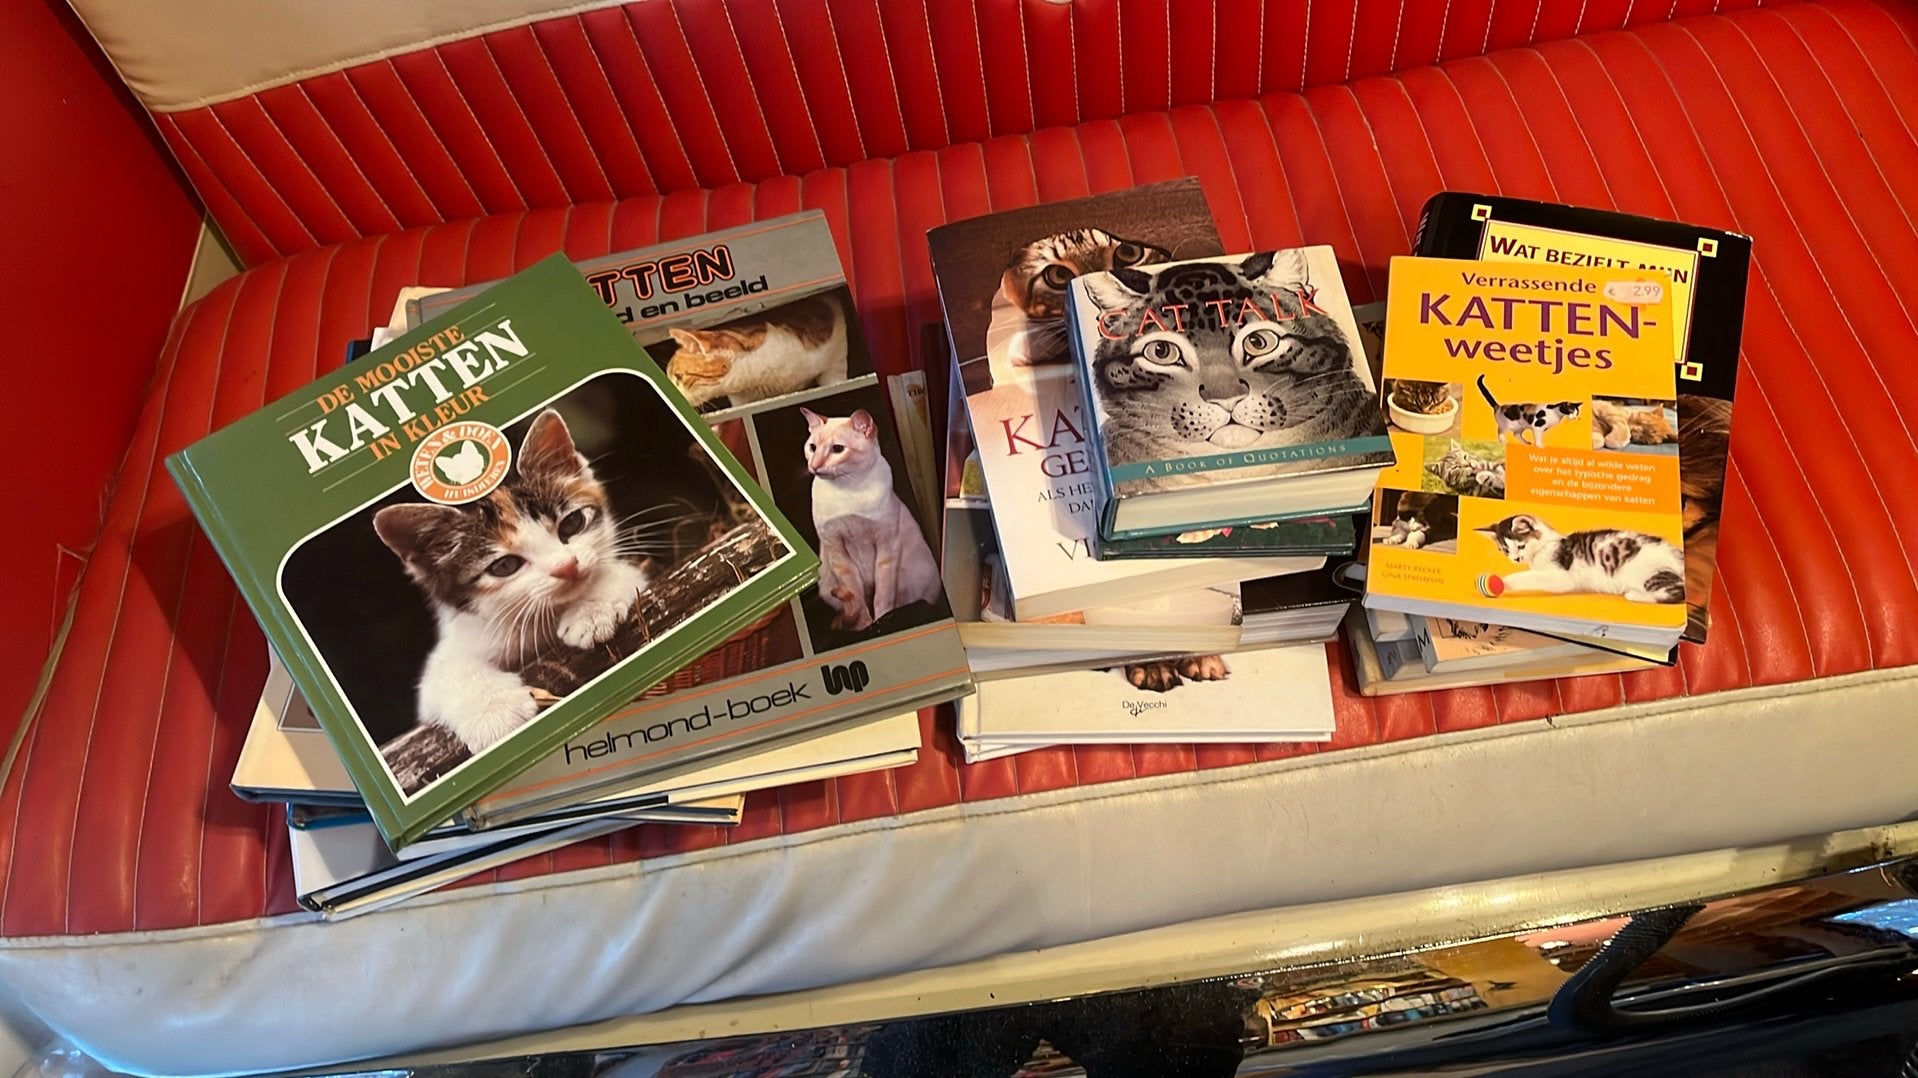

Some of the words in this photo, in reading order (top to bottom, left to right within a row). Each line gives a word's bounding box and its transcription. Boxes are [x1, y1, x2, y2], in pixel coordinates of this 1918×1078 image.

[1490, 236, 1541, 259] WAT
[587, 244, 735, 307] TTEN
[1462, 272, 1597, 293] Verrassende
[641, 300, 680, 318] en
[684, 275, 769, 308] beeld
[1633, 284, 1661, 297] 2.99
[1098, 303, 1189, 340] CAT
[1205, 288, 1328, 328] TALK
[1420, 292, 1657, 339] KATTEN-
[1444, 338, 1613, 375] weetjes
[316, 384, 355, 414] DE
[355, 325, 465, 393] MOOISTE
[289, 319, 529, 475] KATTEN
[369, 433, 401, 461] IN
[403, 385, 490, 442] KLEUR
[999, 405, 1085, 457] KA
[1040, 450, 1089, 478] GE
[1145, 465, 1155, 475] A
[1529, 453, 1547, 462] Wat
[1549, 456, 1558, 464] je
[1561, 457, 1584, 467] altijd
[1598, 460, 1623, 469] wilde
[1626, 463, 1656, 472] weten
[1533, 466, 1553, 474] over
[1556, 467, 1572, 476] het
[1575, 469, 1614, 480] typische
[1617, 473, 1651, 485] gedrag
[1582, 481, 1632, 492] bijzondere
[1037, 486, 1066, 502] ALS
[1068, 481, 1093, 496] HE
[1530, 488, 1601, 501] eigenschappen
[1603, 495, 1621, 503] van
[1624, 496, 1655, 505] katten
[1056, 538, 1092, 561] VI
[1122, 700, 1135, 709] De
[1136, 700, 1167, 709] Vecchi
[564, 682, 812, 765] helmond-boek
